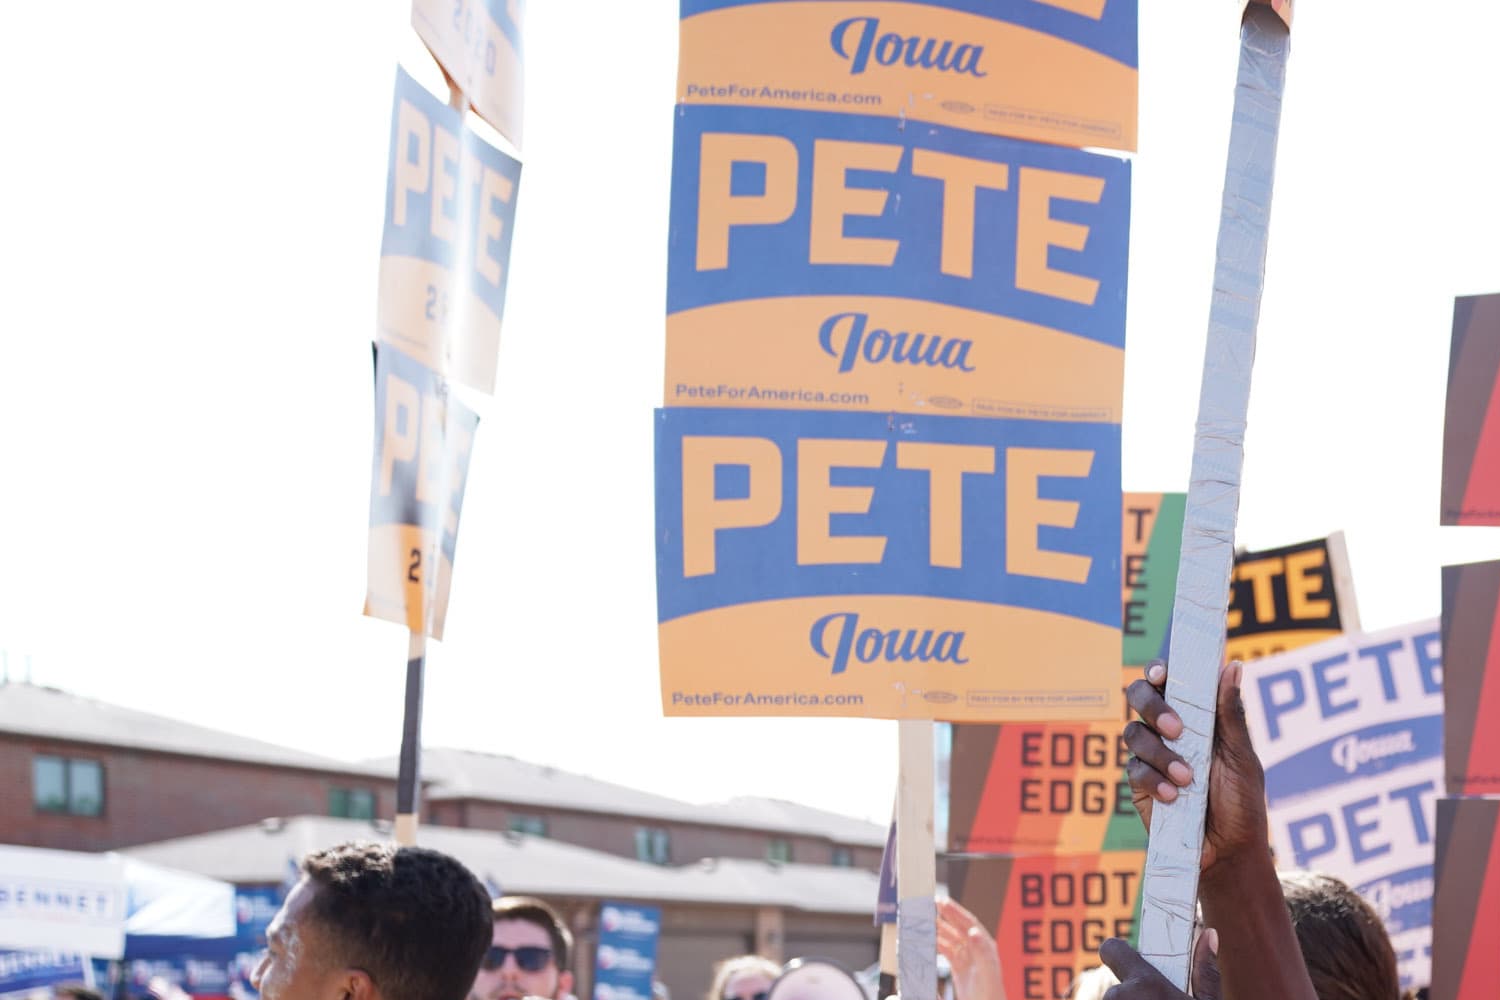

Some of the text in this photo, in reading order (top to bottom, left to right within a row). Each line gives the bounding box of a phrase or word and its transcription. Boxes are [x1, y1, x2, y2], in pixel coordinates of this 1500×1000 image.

[829, 16, 988, 77] Iowa
[686, 83, 883, 107] PeteForAmerica.com
[695, 131, 1107, 306] PETE
[818, 312, 977, 375] Iowa
[675, 383, 870, 405] PeteForAmerica.com
[681, 435, 1096, 585] PETE
[1227, 548, 1332, 629] TE
[809, 612, 970, 675] Iowa
[671, 691, 864, 707] PeteForAmerica.com
[1331, 731, 1415, 773] Iowa
[1020, 779, 1136, 816] EDGE
[1287, 780, 1434, 870] PET
[1021, 872, 1137, 909] BOOT
